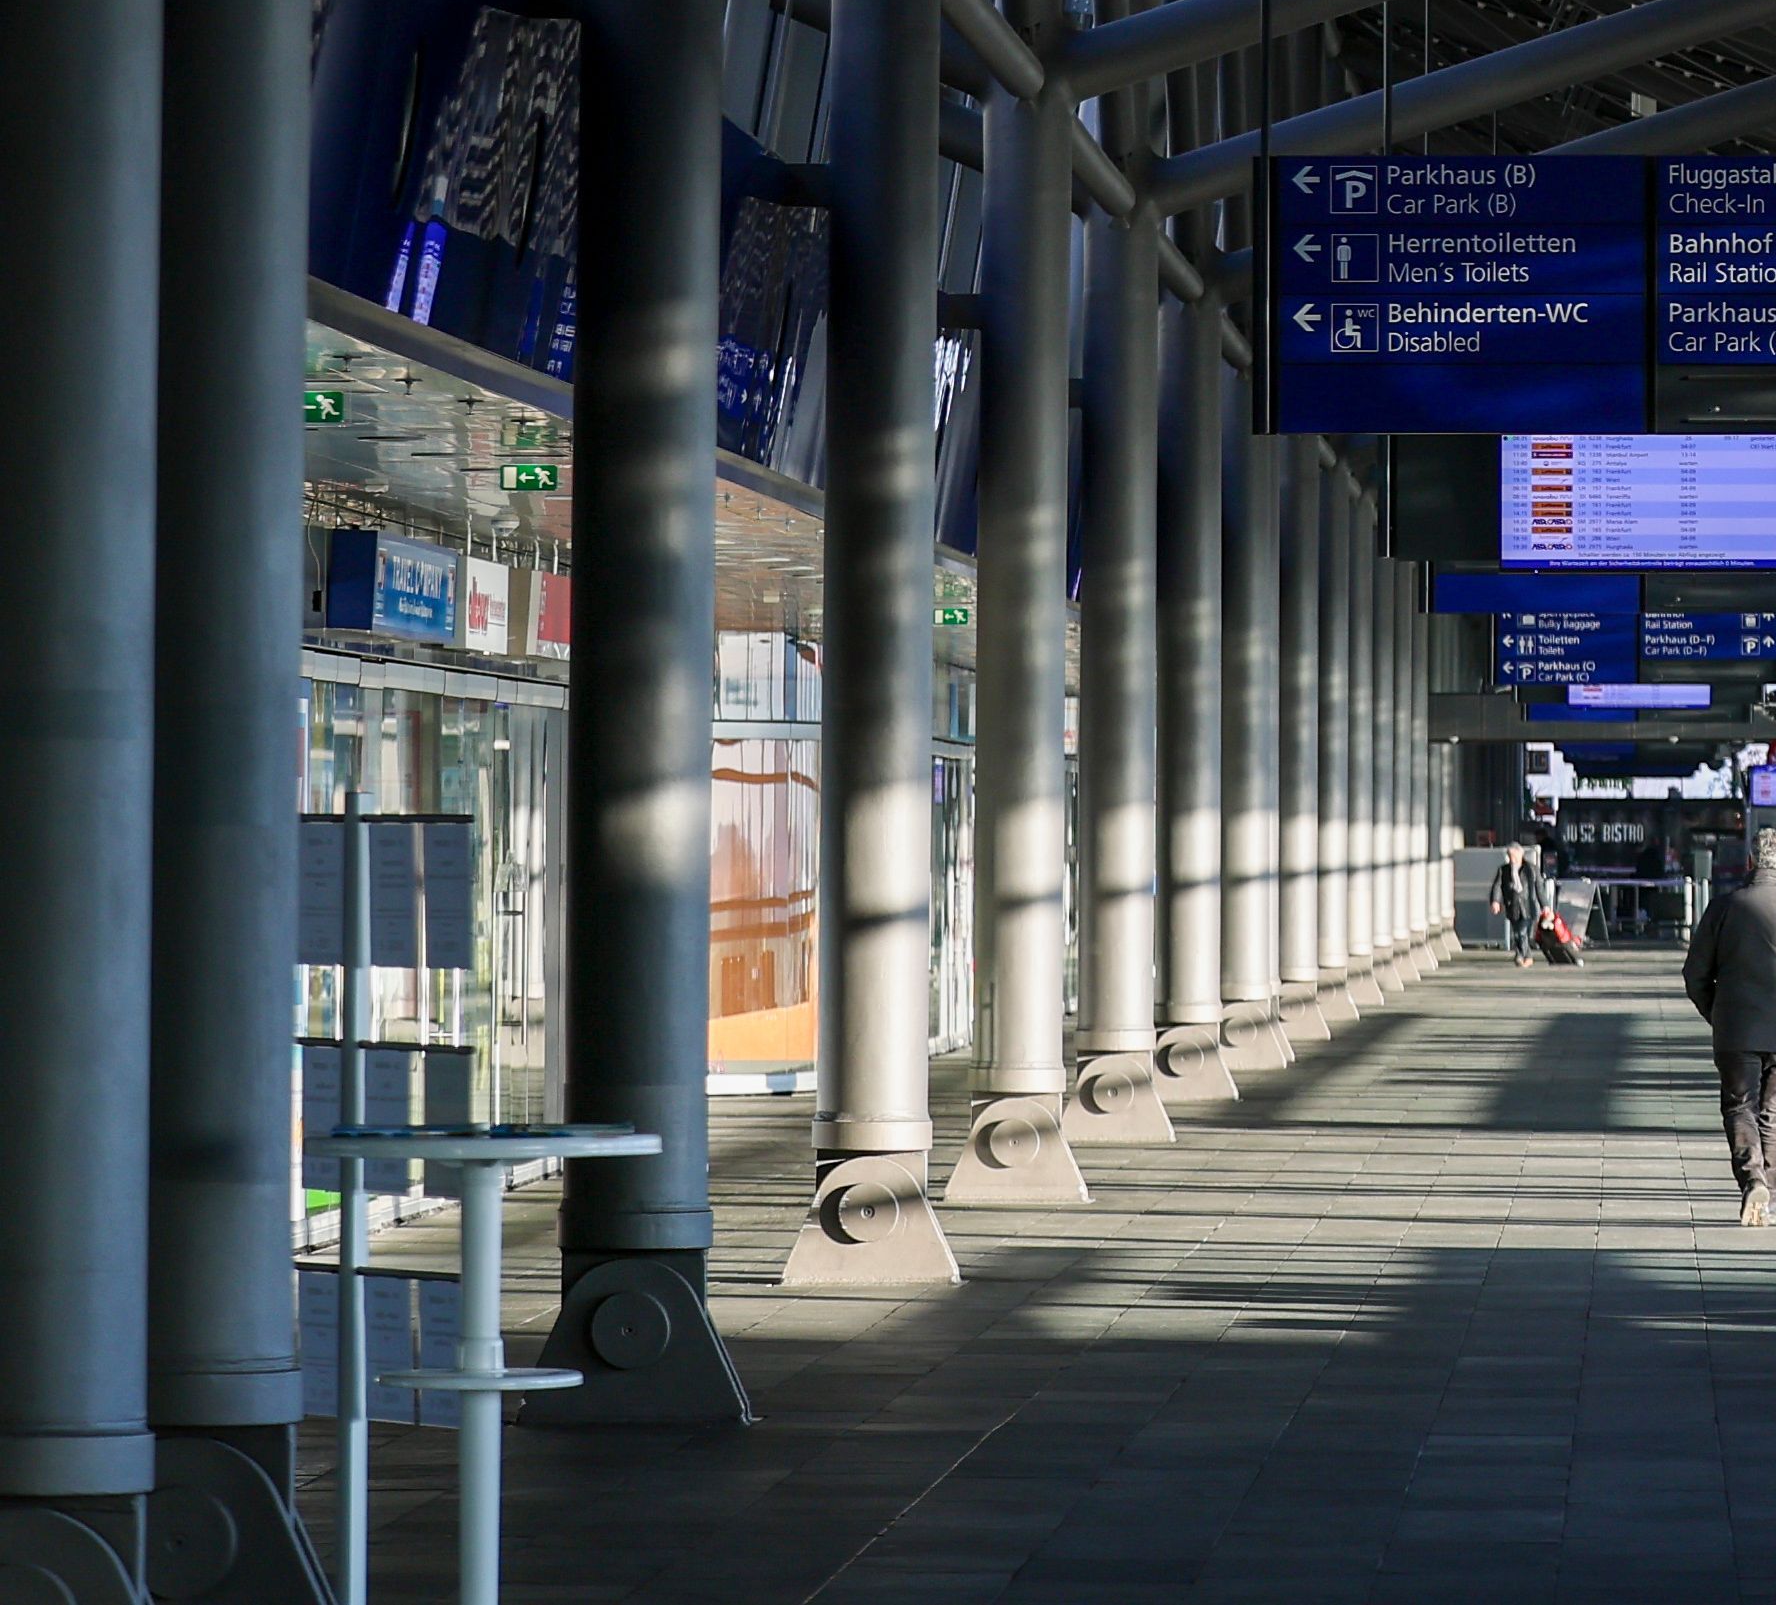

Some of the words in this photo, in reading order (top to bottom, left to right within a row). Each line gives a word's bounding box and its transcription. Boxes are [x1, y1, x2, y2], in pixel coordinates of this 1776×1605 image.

[1386, 165, 1496, 185] Parkhaus
[1504, 164, 1536, 188] (B)
[1387, 194, 1425, 214] Car
[1433, 194, 1480, 214] Park
[1488, 193, 1516, 217] (B)
[1668, 194, 1765, 214] Check-In
[1388, 233, 1577, 253] Herrentoiletten
[1669, 233, 1774, 253] Bahnhof
[1461, 263, 1530, 283] Toilets
[1669, 263, 1707, 283] Rail
[1388, 303, 1588, 323] Behinderten-WC
[1668, 303, 1776, 323] Parkhaus
[1388, 331, 1480, 352] Disabled
[1668, 332, 1706, 352] Car
[1715, 332, 1760, 352] Park
[1538, 620, 1560, 631] Bulky
[1563, 620, 1600, 631] Baggage
[1645, 620, 1661, 629] Rail
[1662, 620, 1693, 629] Station
[1538, 635, 1580, 645] Toiletten
[1645, 635, 1687, 644] Parkhaus
[1538, 646, 1565, 656] Toilets
[1645, 646, 1660, 656] Car
[1662, 646, 1681, 656] Park
[1538, 661, 1581, 671] Parkhaus
[1583, 661, 1596, 672] (C)
[1538, 672, 1553, 681] Car
[1555, 672, 1574, 681] Park
[1576, 672, 1590, 682] (C)
[1563, 824, 1578, 843] JU
[1580, 824, 1595, 843] 52
[1603, 823, 1645, 843] BISTRO
